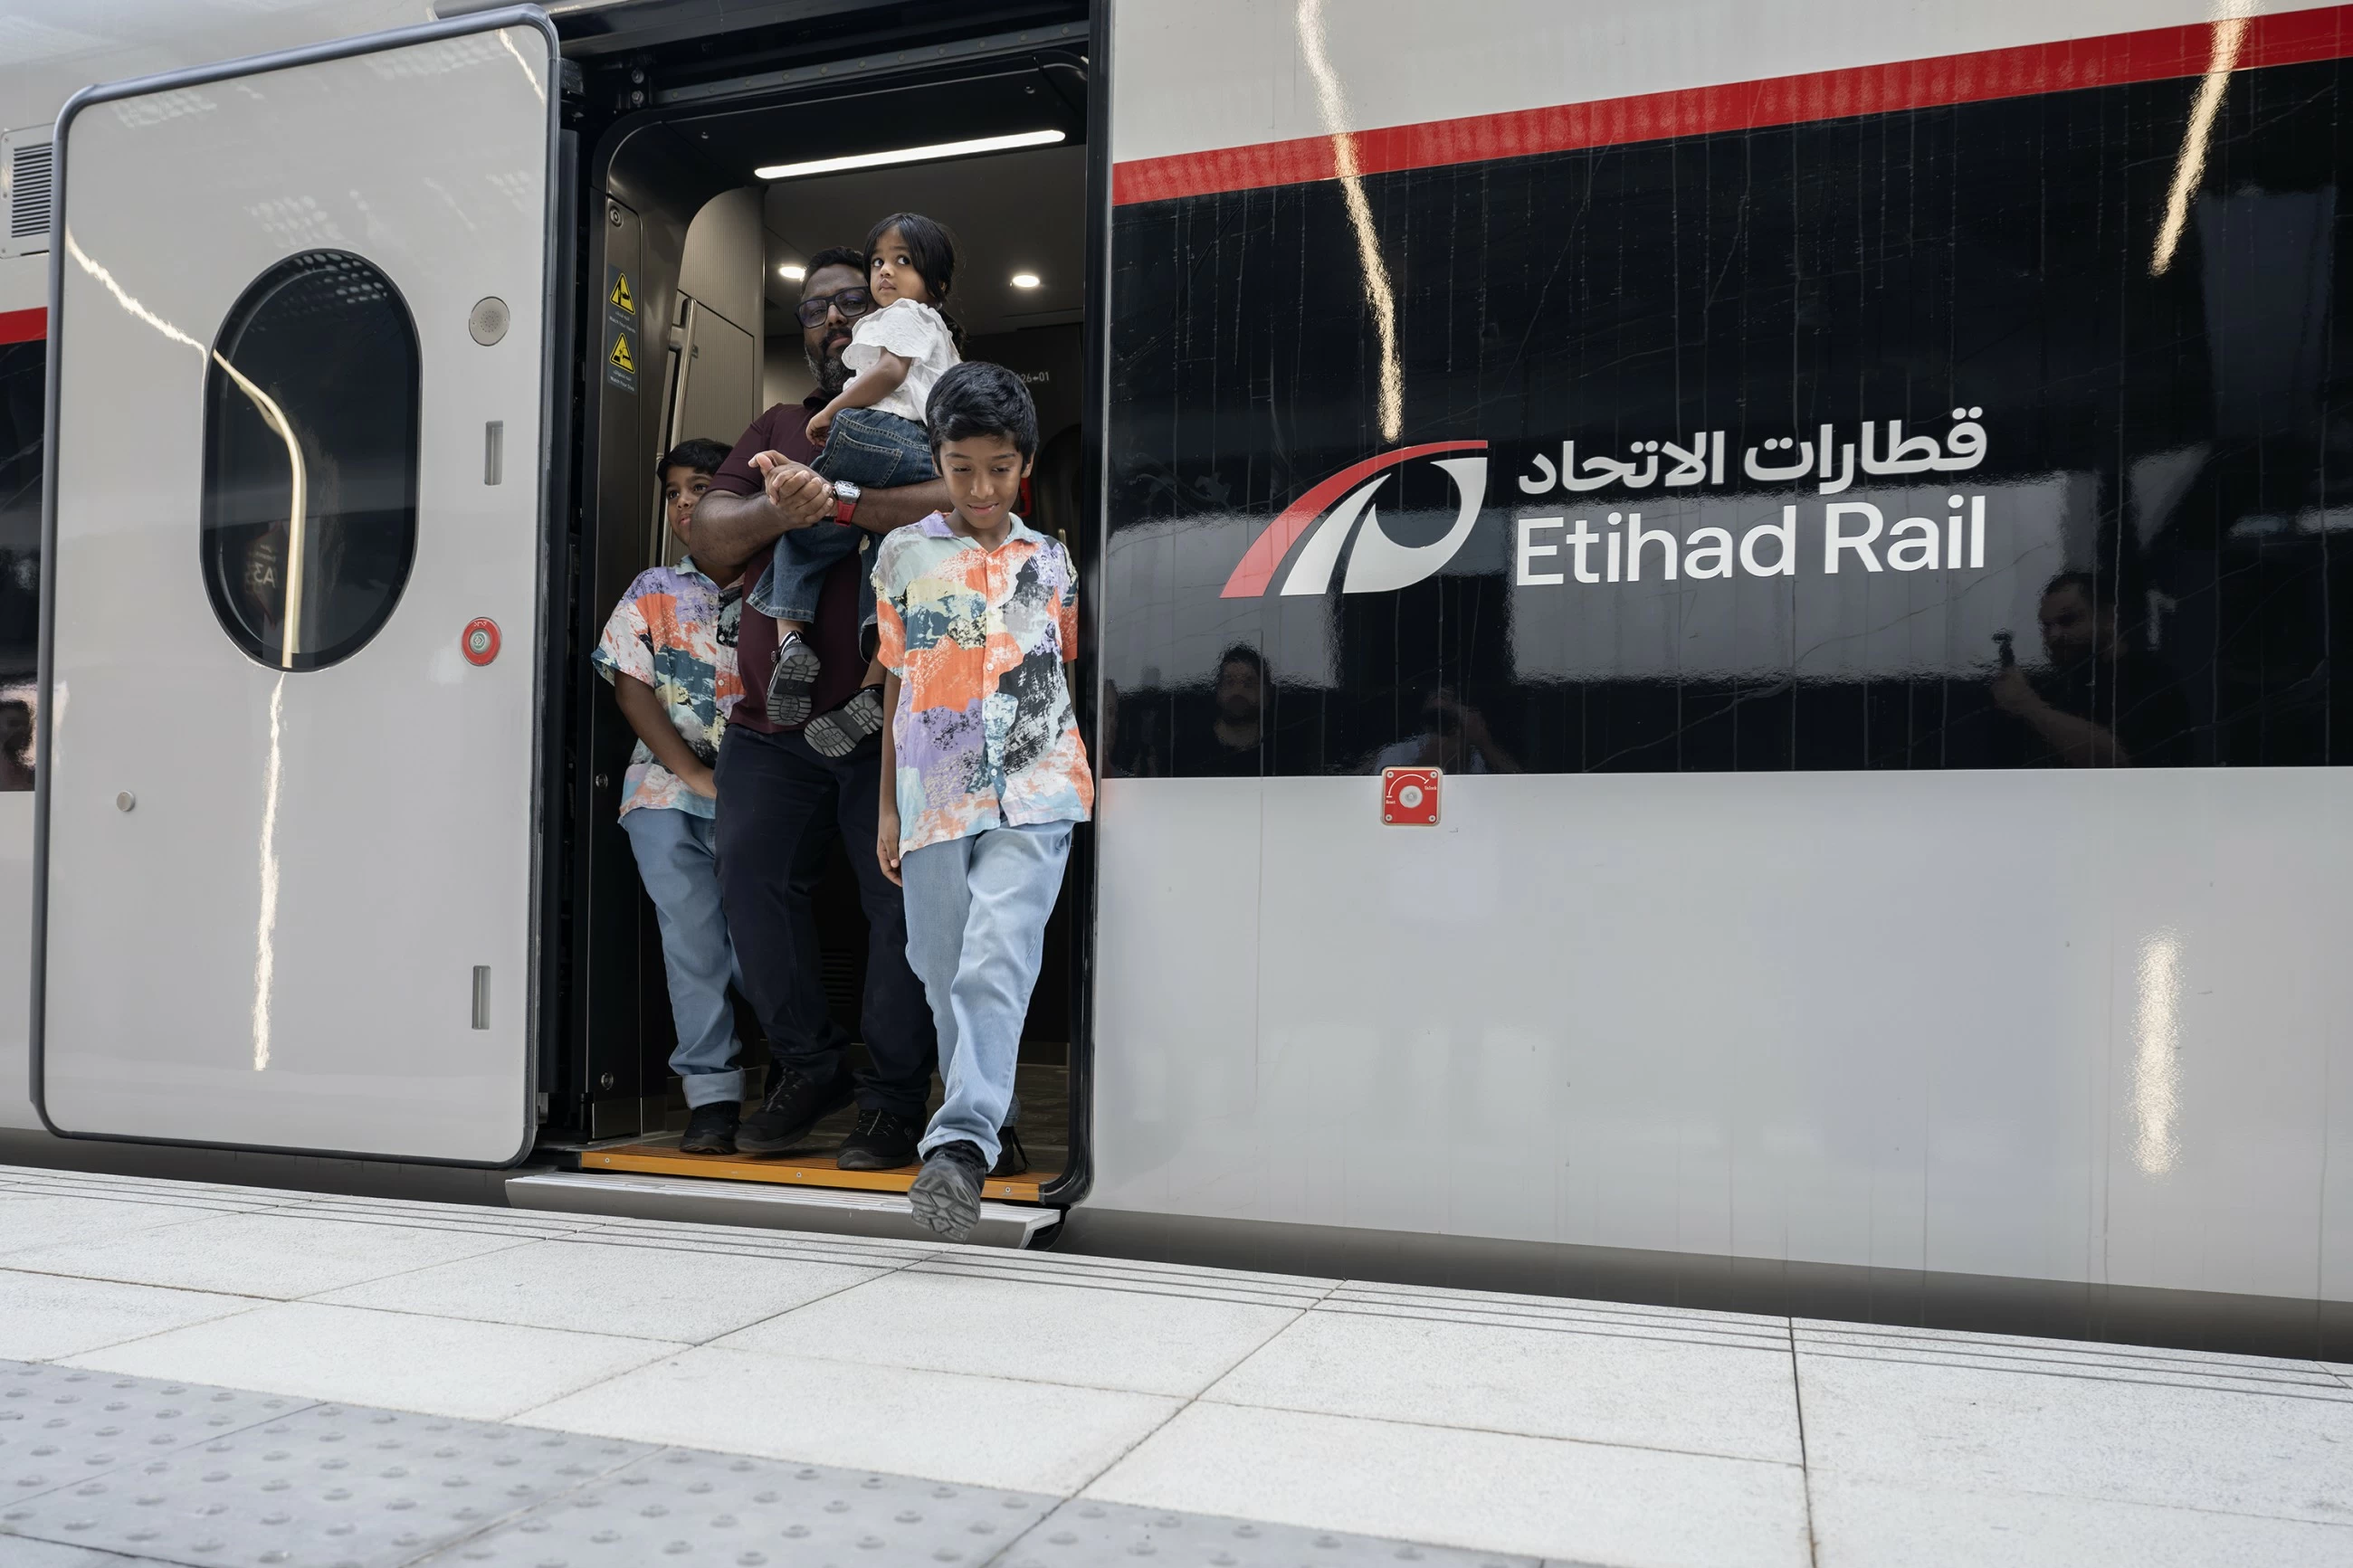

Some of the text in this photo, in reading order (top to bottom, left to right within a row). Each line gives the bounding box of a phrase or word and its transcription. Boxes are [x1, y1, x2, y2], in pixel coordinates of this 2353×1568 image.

[1519, 406, 1988, 495] قطارات الاتحاد
[1516, 494, 1986, 586] Etihad Rail
